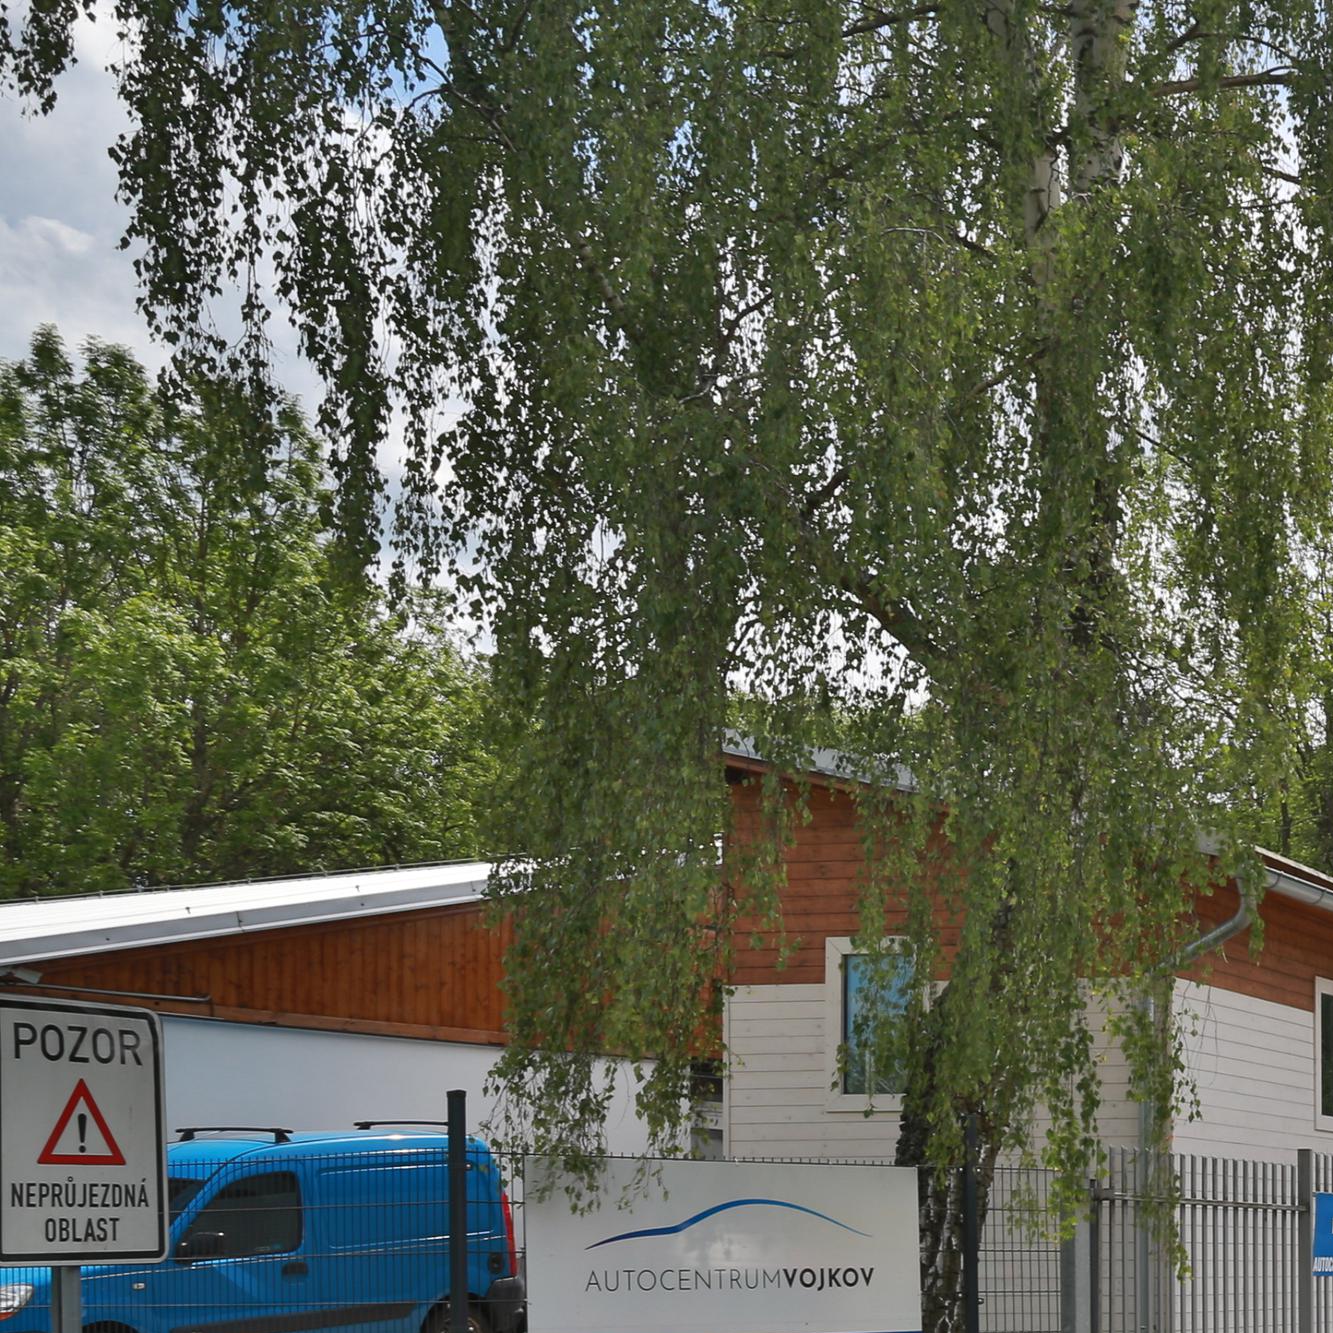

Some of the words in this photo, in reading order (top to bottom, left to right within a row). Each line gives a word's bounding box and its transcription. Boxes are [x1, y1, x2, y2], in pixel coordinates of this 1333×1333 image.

[13, 1022, 143, 1066] POZOR
[11, 1176, 149, 1208] NEPRŮJEZDNÁ
[45, 1217, 119, 1242] OBLAST
